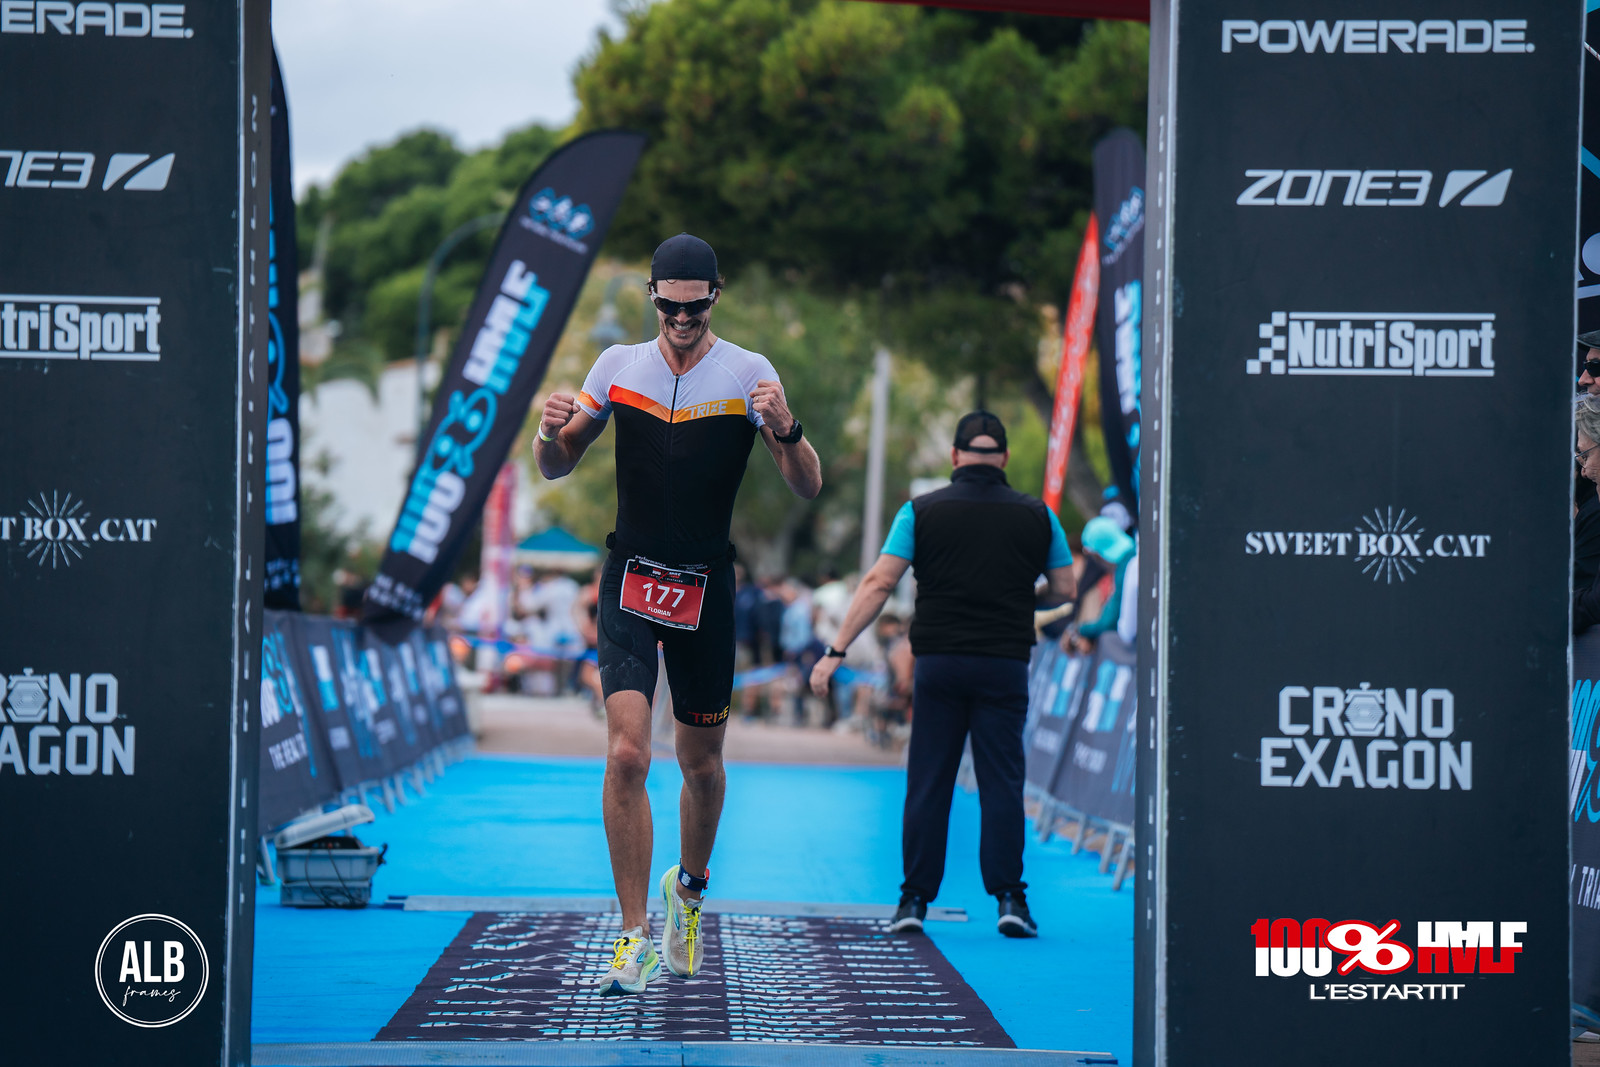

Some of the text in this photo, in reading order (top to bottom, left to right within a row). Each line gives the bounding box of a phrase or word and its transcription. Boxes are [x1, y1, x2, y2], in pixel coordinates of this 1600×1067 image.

[1221, 19, 1535, 53] POWERADE.
[1236, 169, 1433, 206] ZONE3
[1288, 320, 1495, 376] NutriSport
[1245, 532, 1352, 556] SWEET
[643, 583, 685, 608] 177
[648, 606, 671, 617] FLORIAN
[1278, 682, 1455, 738] CRONO
[1260, 737, 1472, 790] EXAGON
